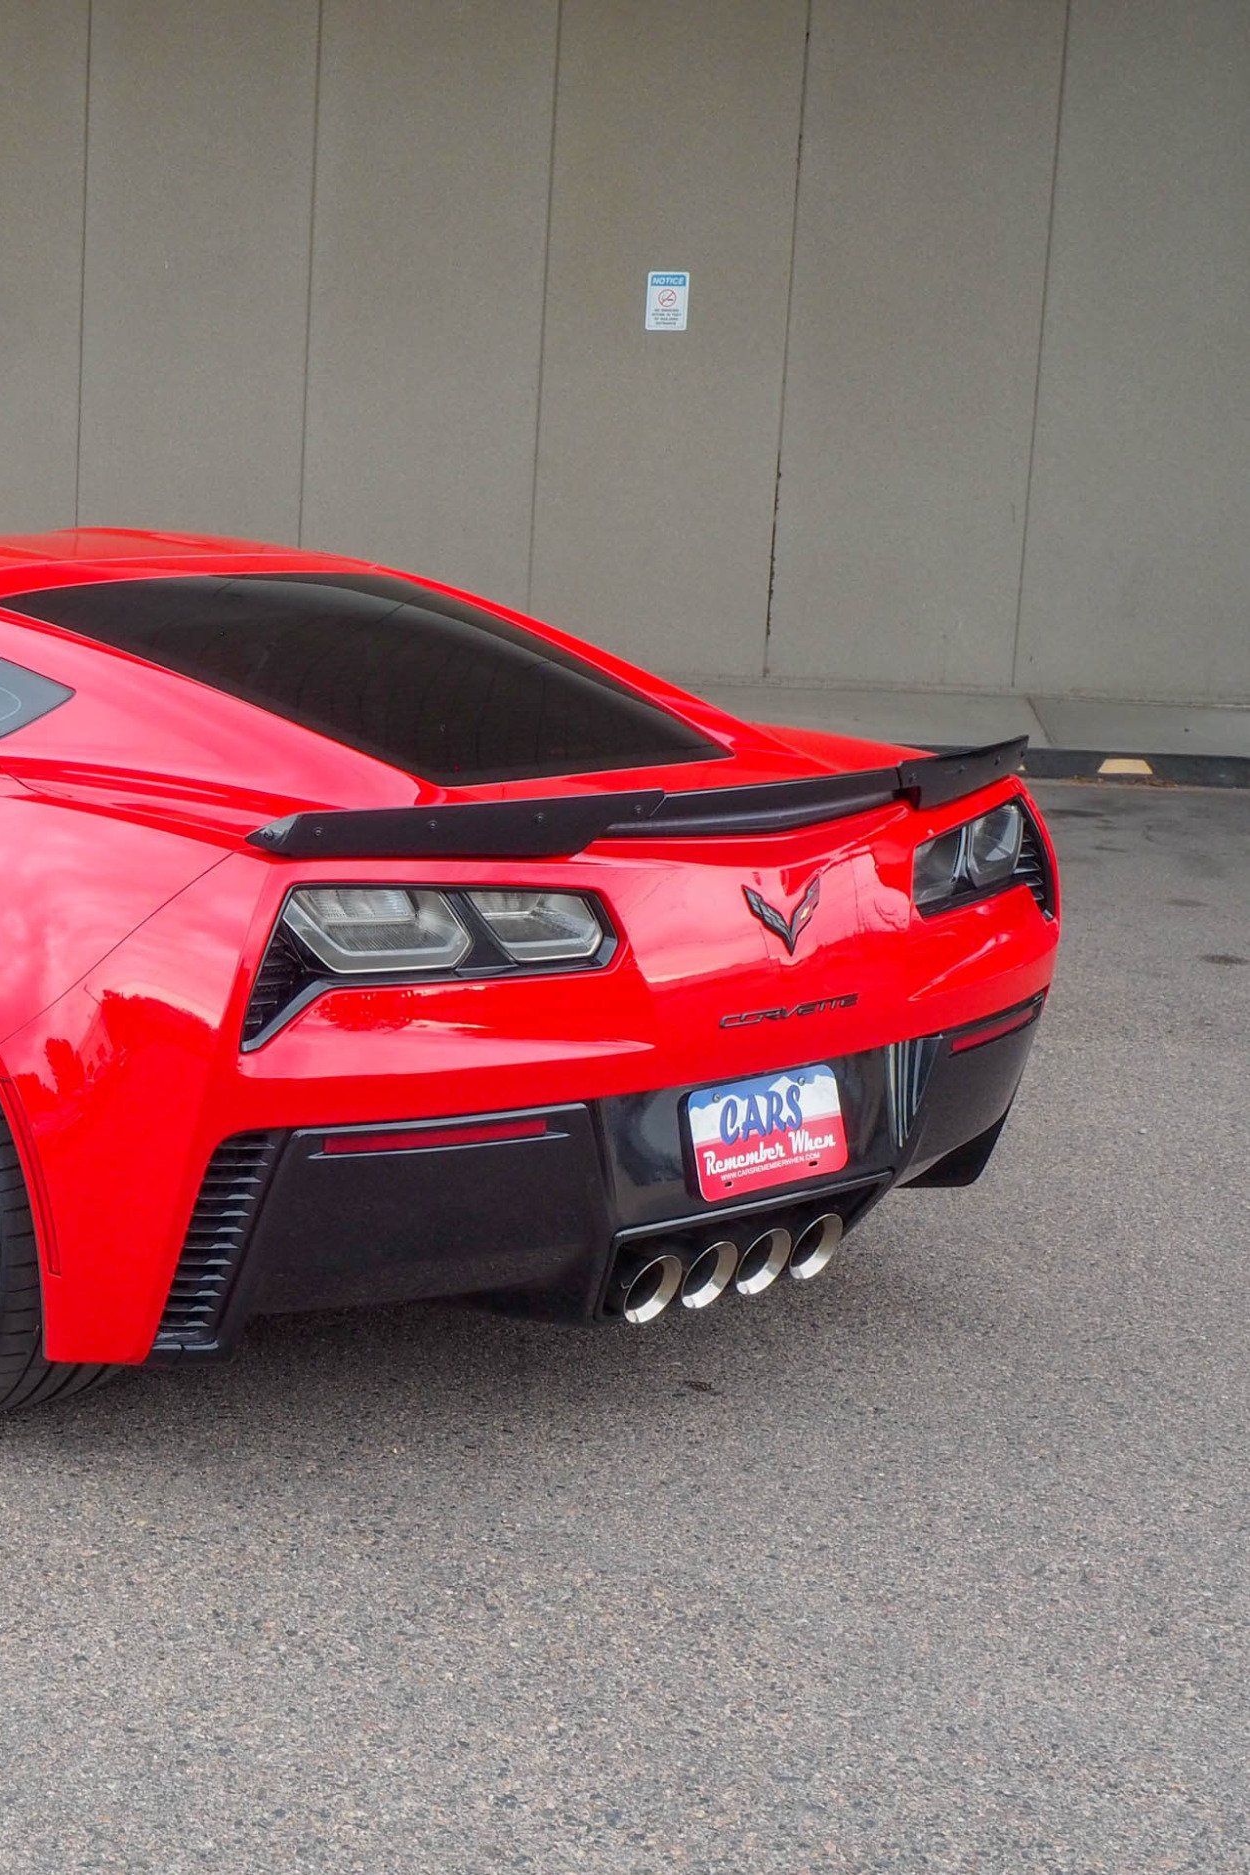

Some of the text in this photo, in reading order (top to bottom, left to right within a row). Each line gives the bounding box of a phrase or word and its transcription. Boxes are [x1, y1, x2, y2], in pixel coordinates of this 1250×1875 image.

[652, 276, 685, 285] NOTICE
[719, 993, 859, 1028] CORVETTE
[720, 1084, 803, 1145] CARS
[703, 1129, 837, 1176] Remember When
